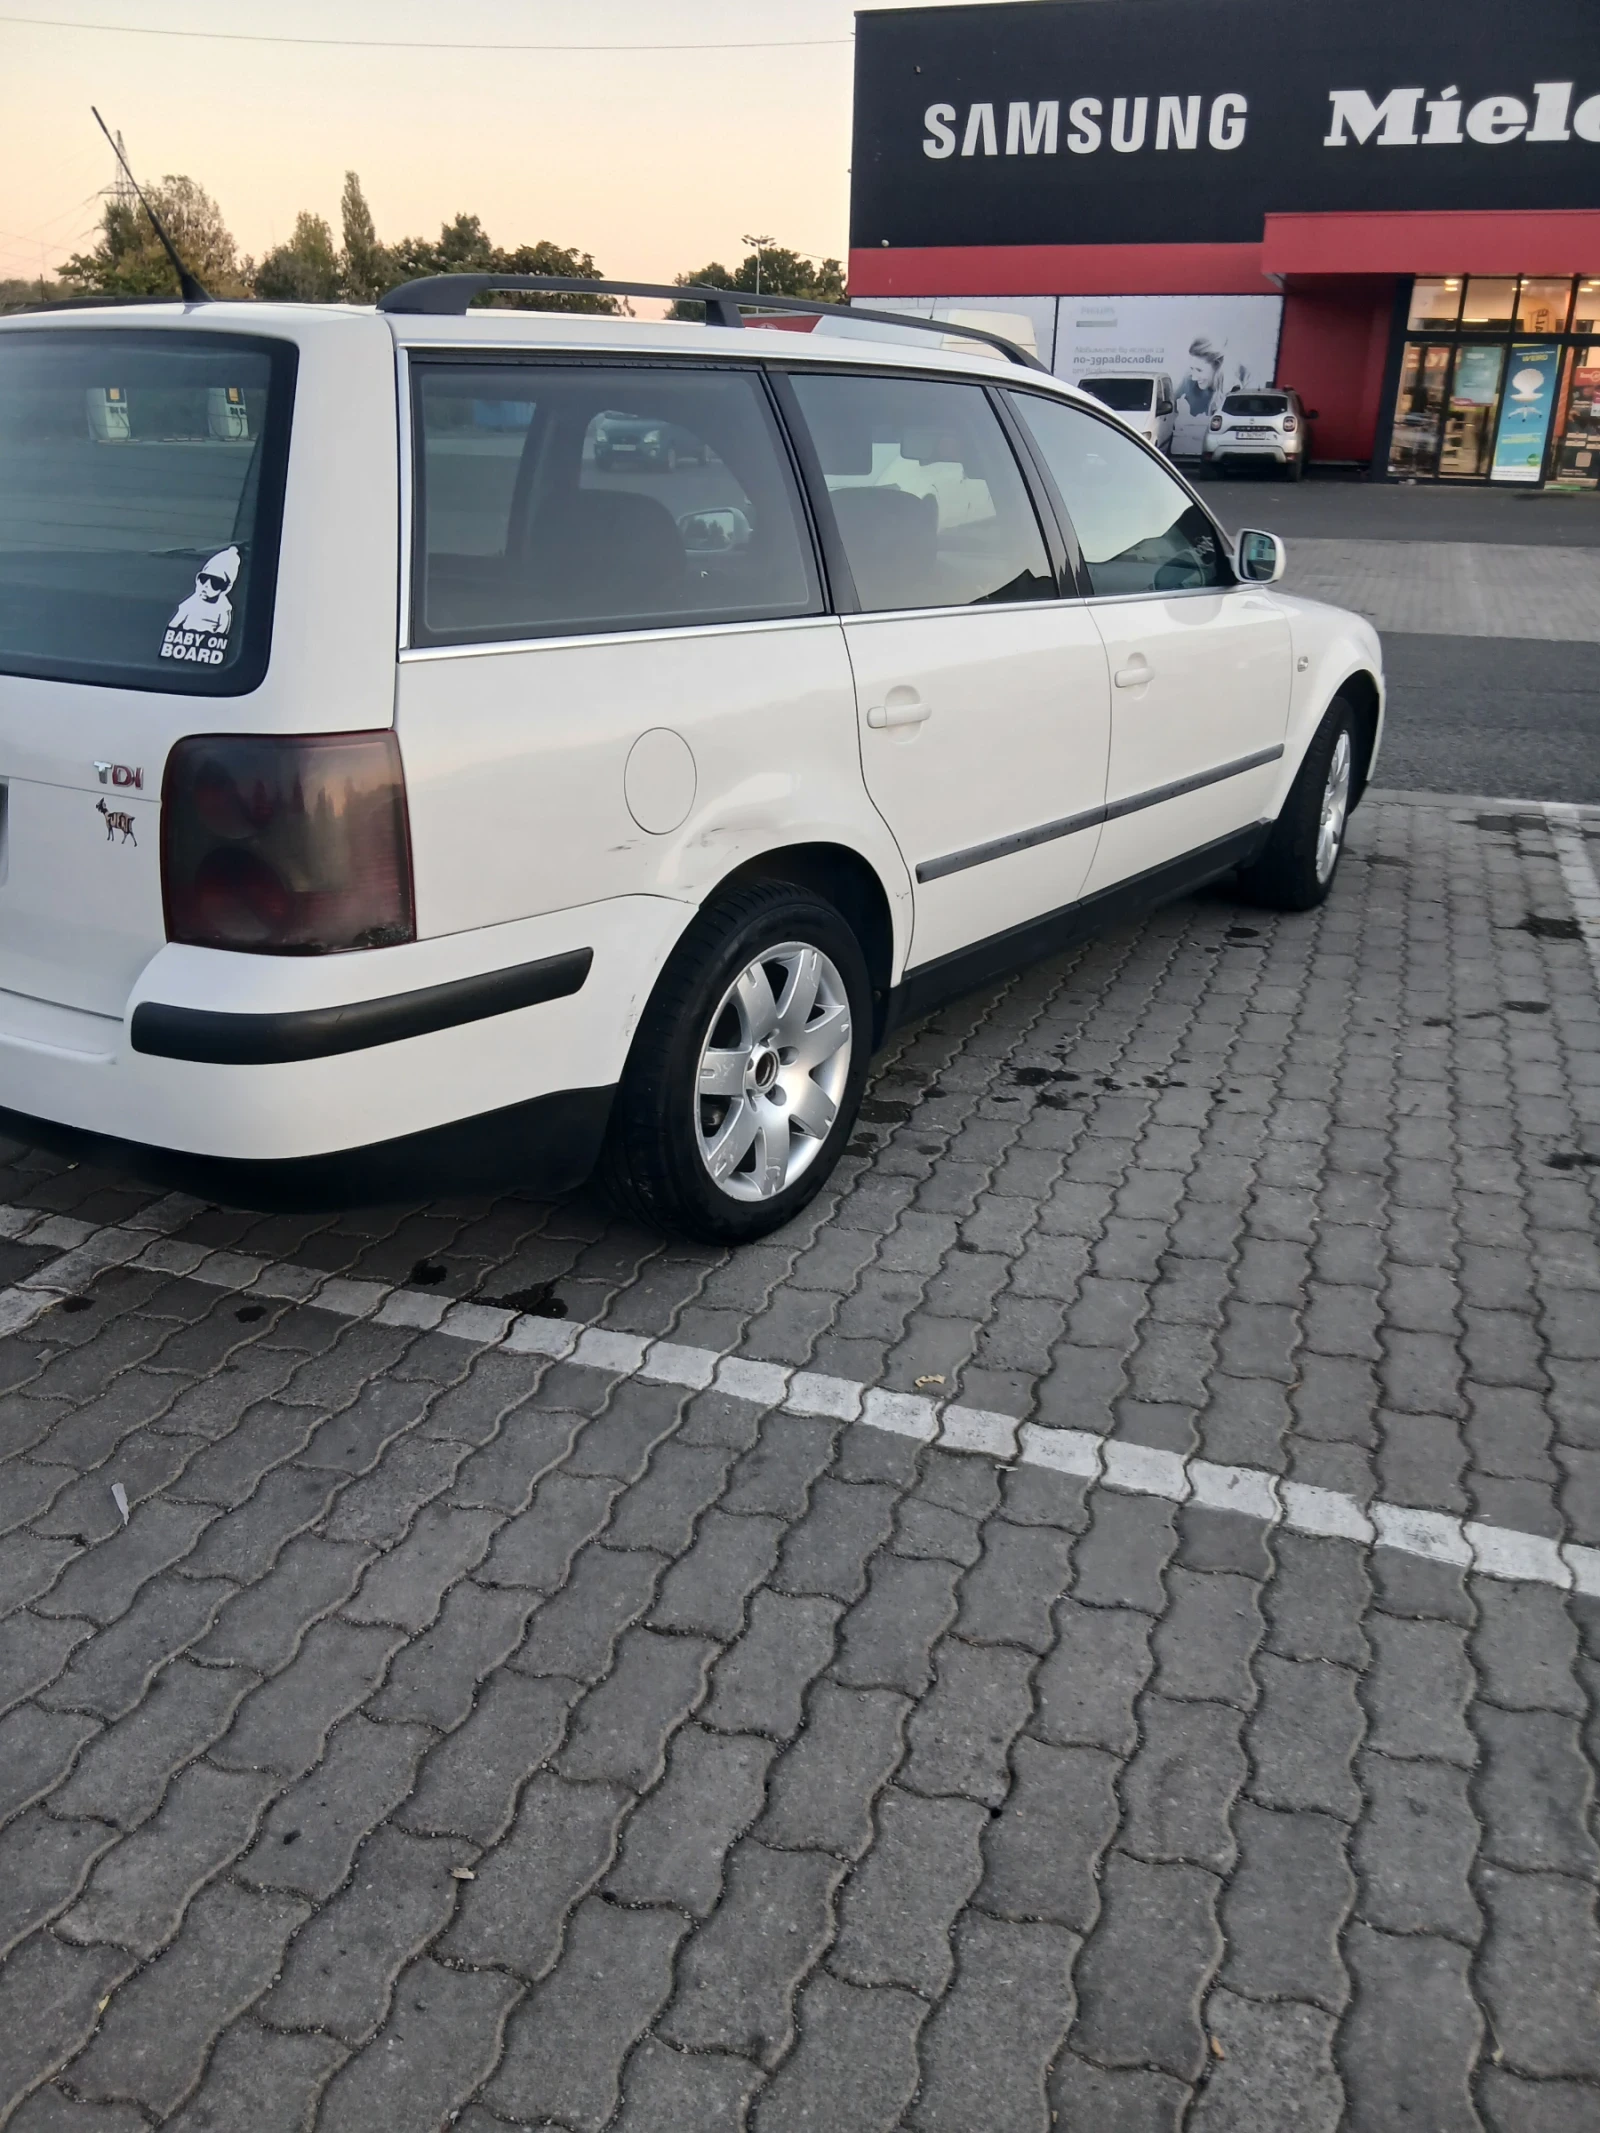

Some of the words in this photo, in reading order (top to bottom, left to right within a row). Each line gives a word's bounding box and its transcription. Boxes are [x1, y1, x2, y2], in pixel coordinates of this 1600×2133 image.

[923, 93, 1247, 159] SAMSUNG
[1073, 354, 1164, 366] по-здравословни
[164, 629, 206, 647] BABY
[207, 636, 228, 650] ON
[160, 642, 224, 665] BOARD
[93, 760, 144, 791] TDI
